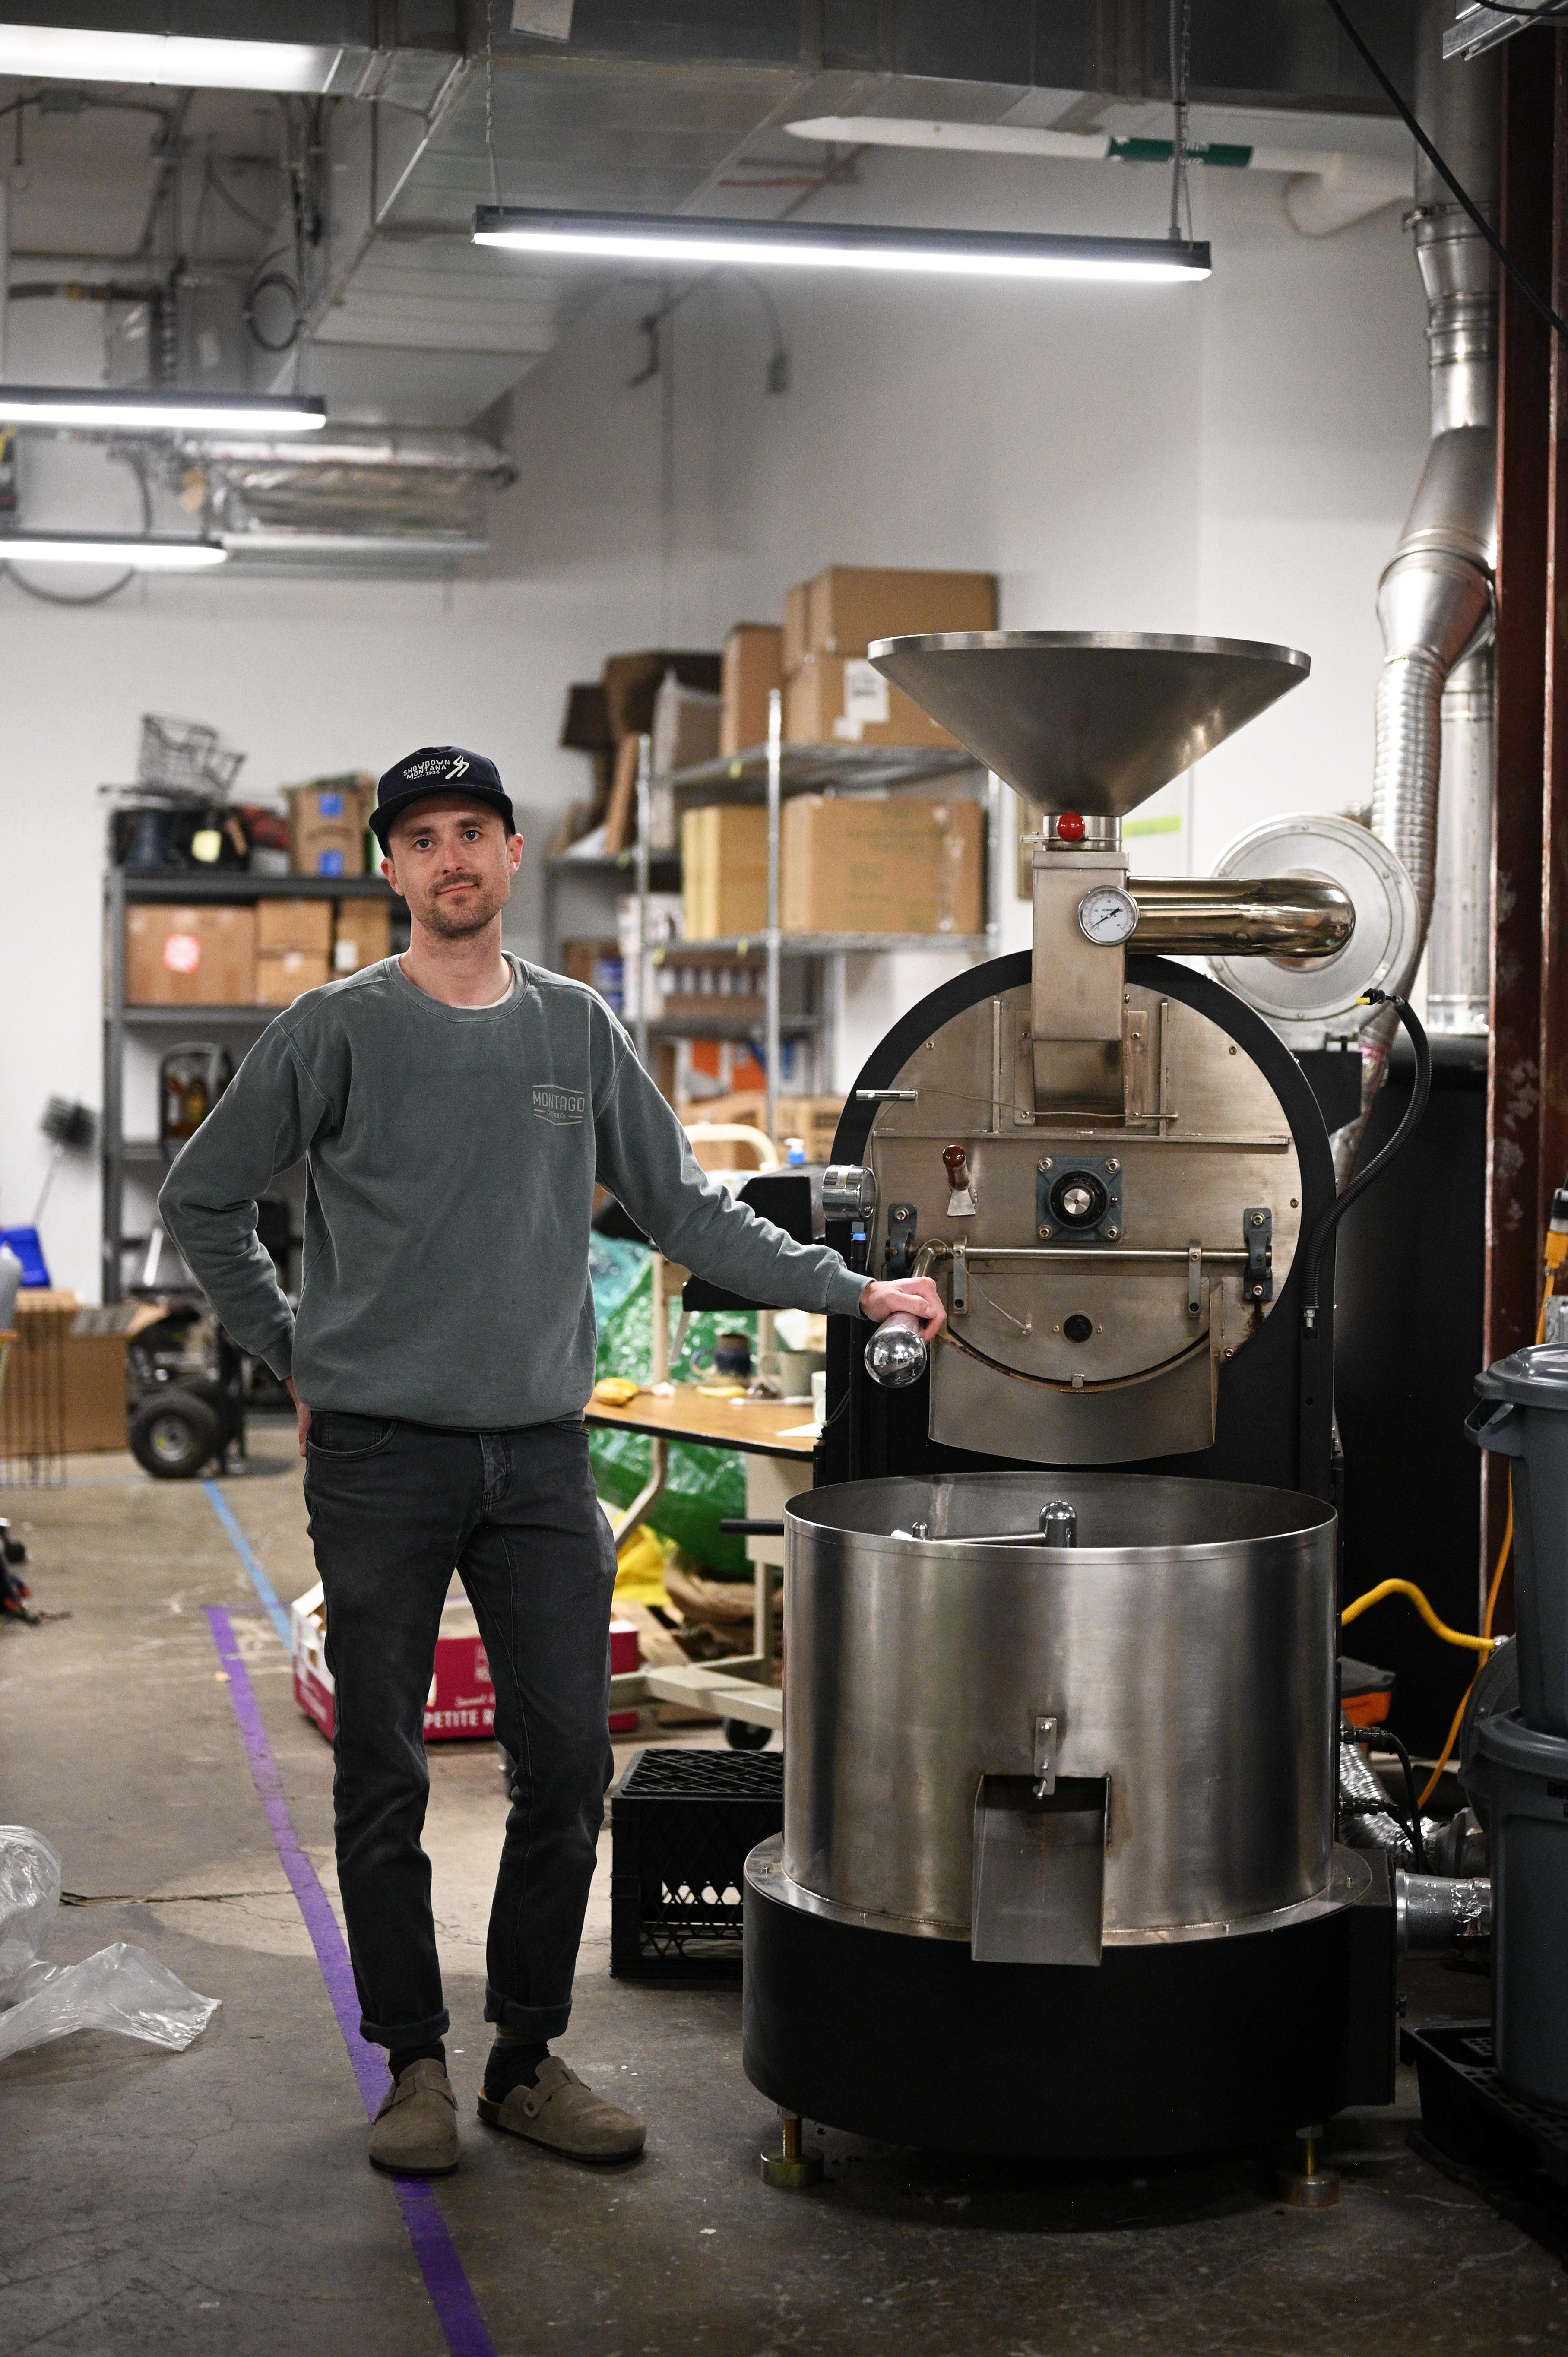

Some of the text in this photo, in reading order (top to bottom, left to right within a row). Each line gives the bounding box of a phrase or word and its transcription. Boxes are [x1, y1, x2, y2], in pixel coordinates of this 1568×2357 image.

[403, 759, 450, 776] SHOWDOWN
[406, 765, 447, 780] MONTANA
[532, 1090, 586, 1112] MONTAGO
